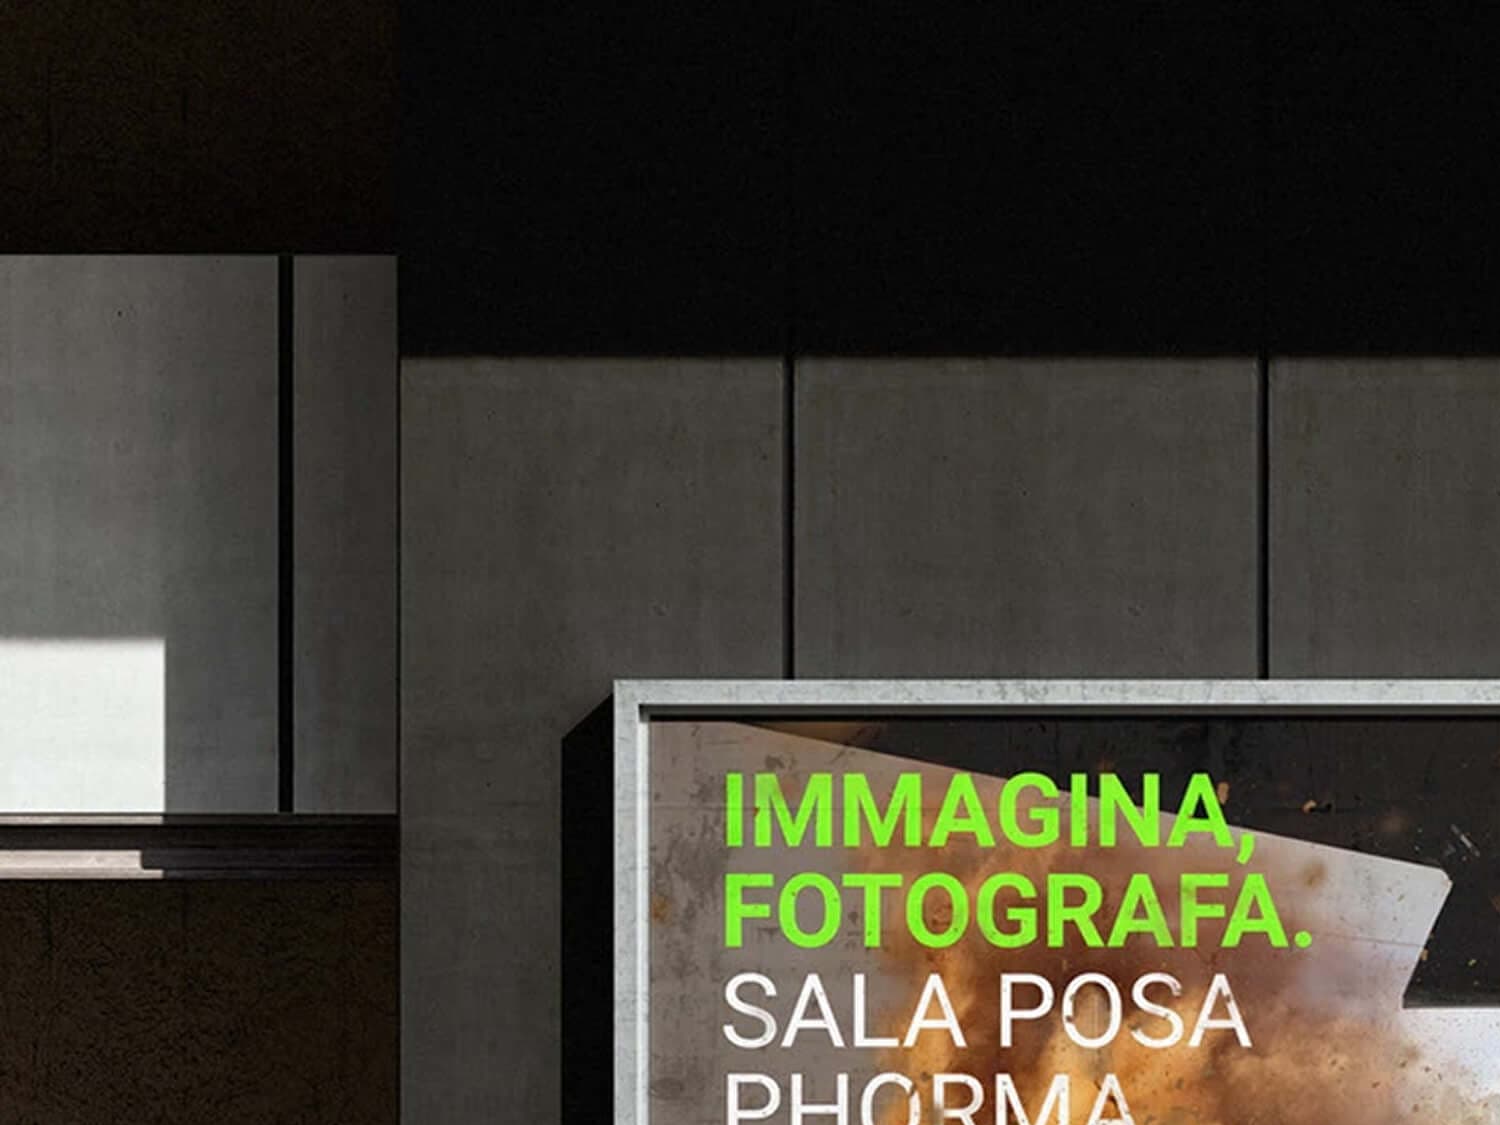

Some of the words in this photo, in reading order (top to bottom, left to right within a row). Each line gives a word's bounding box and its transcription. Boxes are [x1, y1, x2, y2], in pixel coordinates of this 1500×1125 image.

[724, 773, 1256, 864] IMMAGINA,
[724, 873, 1312, 948] FOTOGRAFA.
[723, 973, 966, 1047] SALA
[1001, 973, 1252, 1047] POSA
